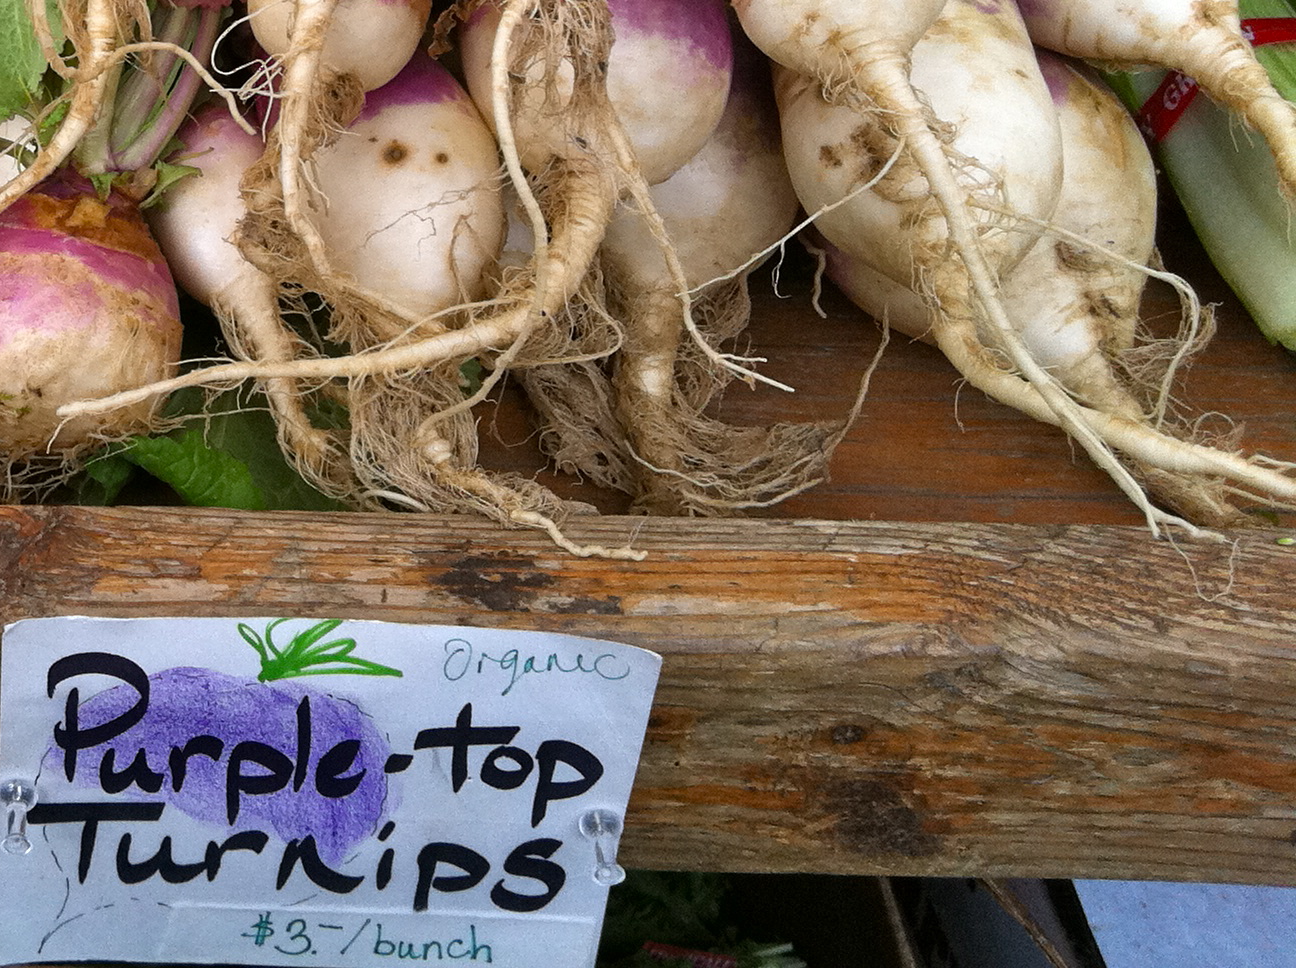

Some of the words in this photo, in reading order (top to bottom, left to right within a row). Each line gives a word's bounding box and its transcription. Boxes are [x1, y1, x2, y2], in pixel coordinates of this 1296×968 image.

[442, 637, 631, 696] Organic
[46, 651, 604, 826] Purple-top
[26, 800, 568, 913] Turnips
